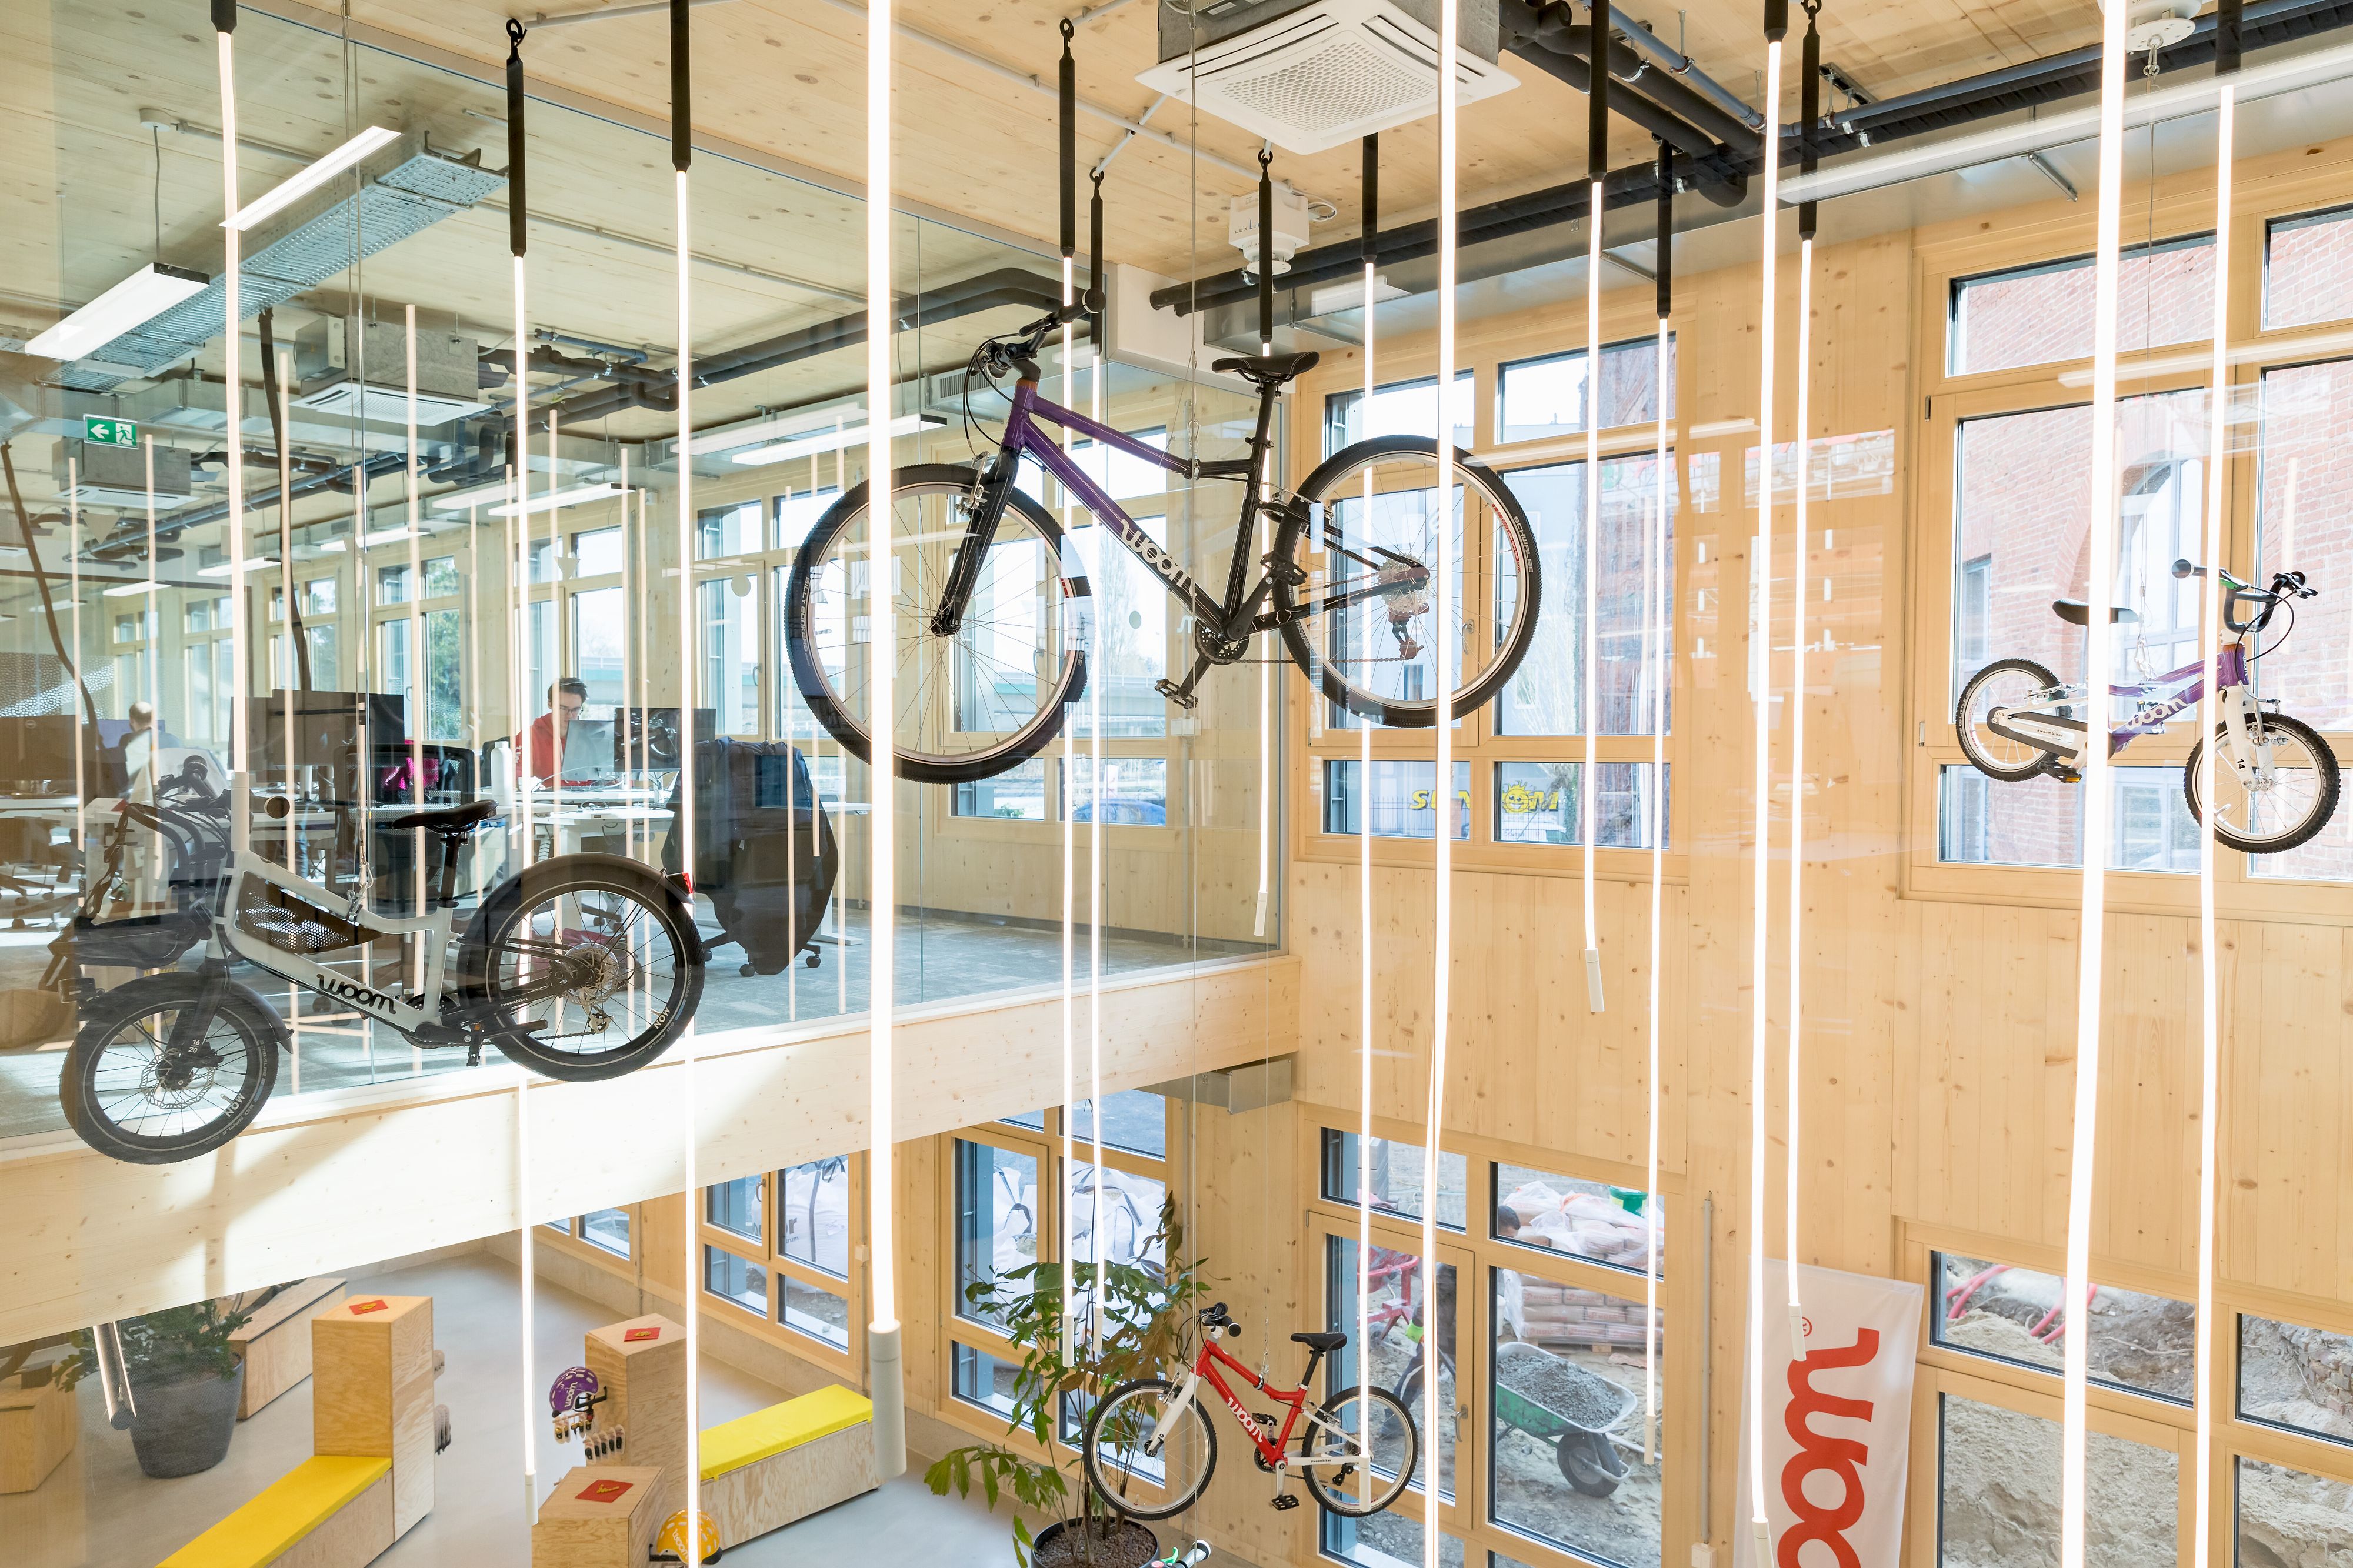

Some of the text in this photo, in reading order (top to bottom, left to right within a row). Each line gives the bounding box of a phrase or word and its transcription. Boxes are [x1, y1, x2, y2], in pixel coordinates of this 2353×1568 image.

[1513, 516, 1534, 573] SCHWALBE
[1121, 518, 1198, 598] woom
[2125, 697, 2192, 730] woom
[2037, 729, 2064, 738] #woombikes
[2237, 758, 2246, 770] 14
[316, 973, 397, 1015] woom
[500, 997, 528, 1007] #woombikes
[654, 1006, 671, 1029] NOW
[225, 1093, 246, 1117] NOW
[564, 1382, 578, 1407] woom
[1226, 1397, 1263, 1443] woom
